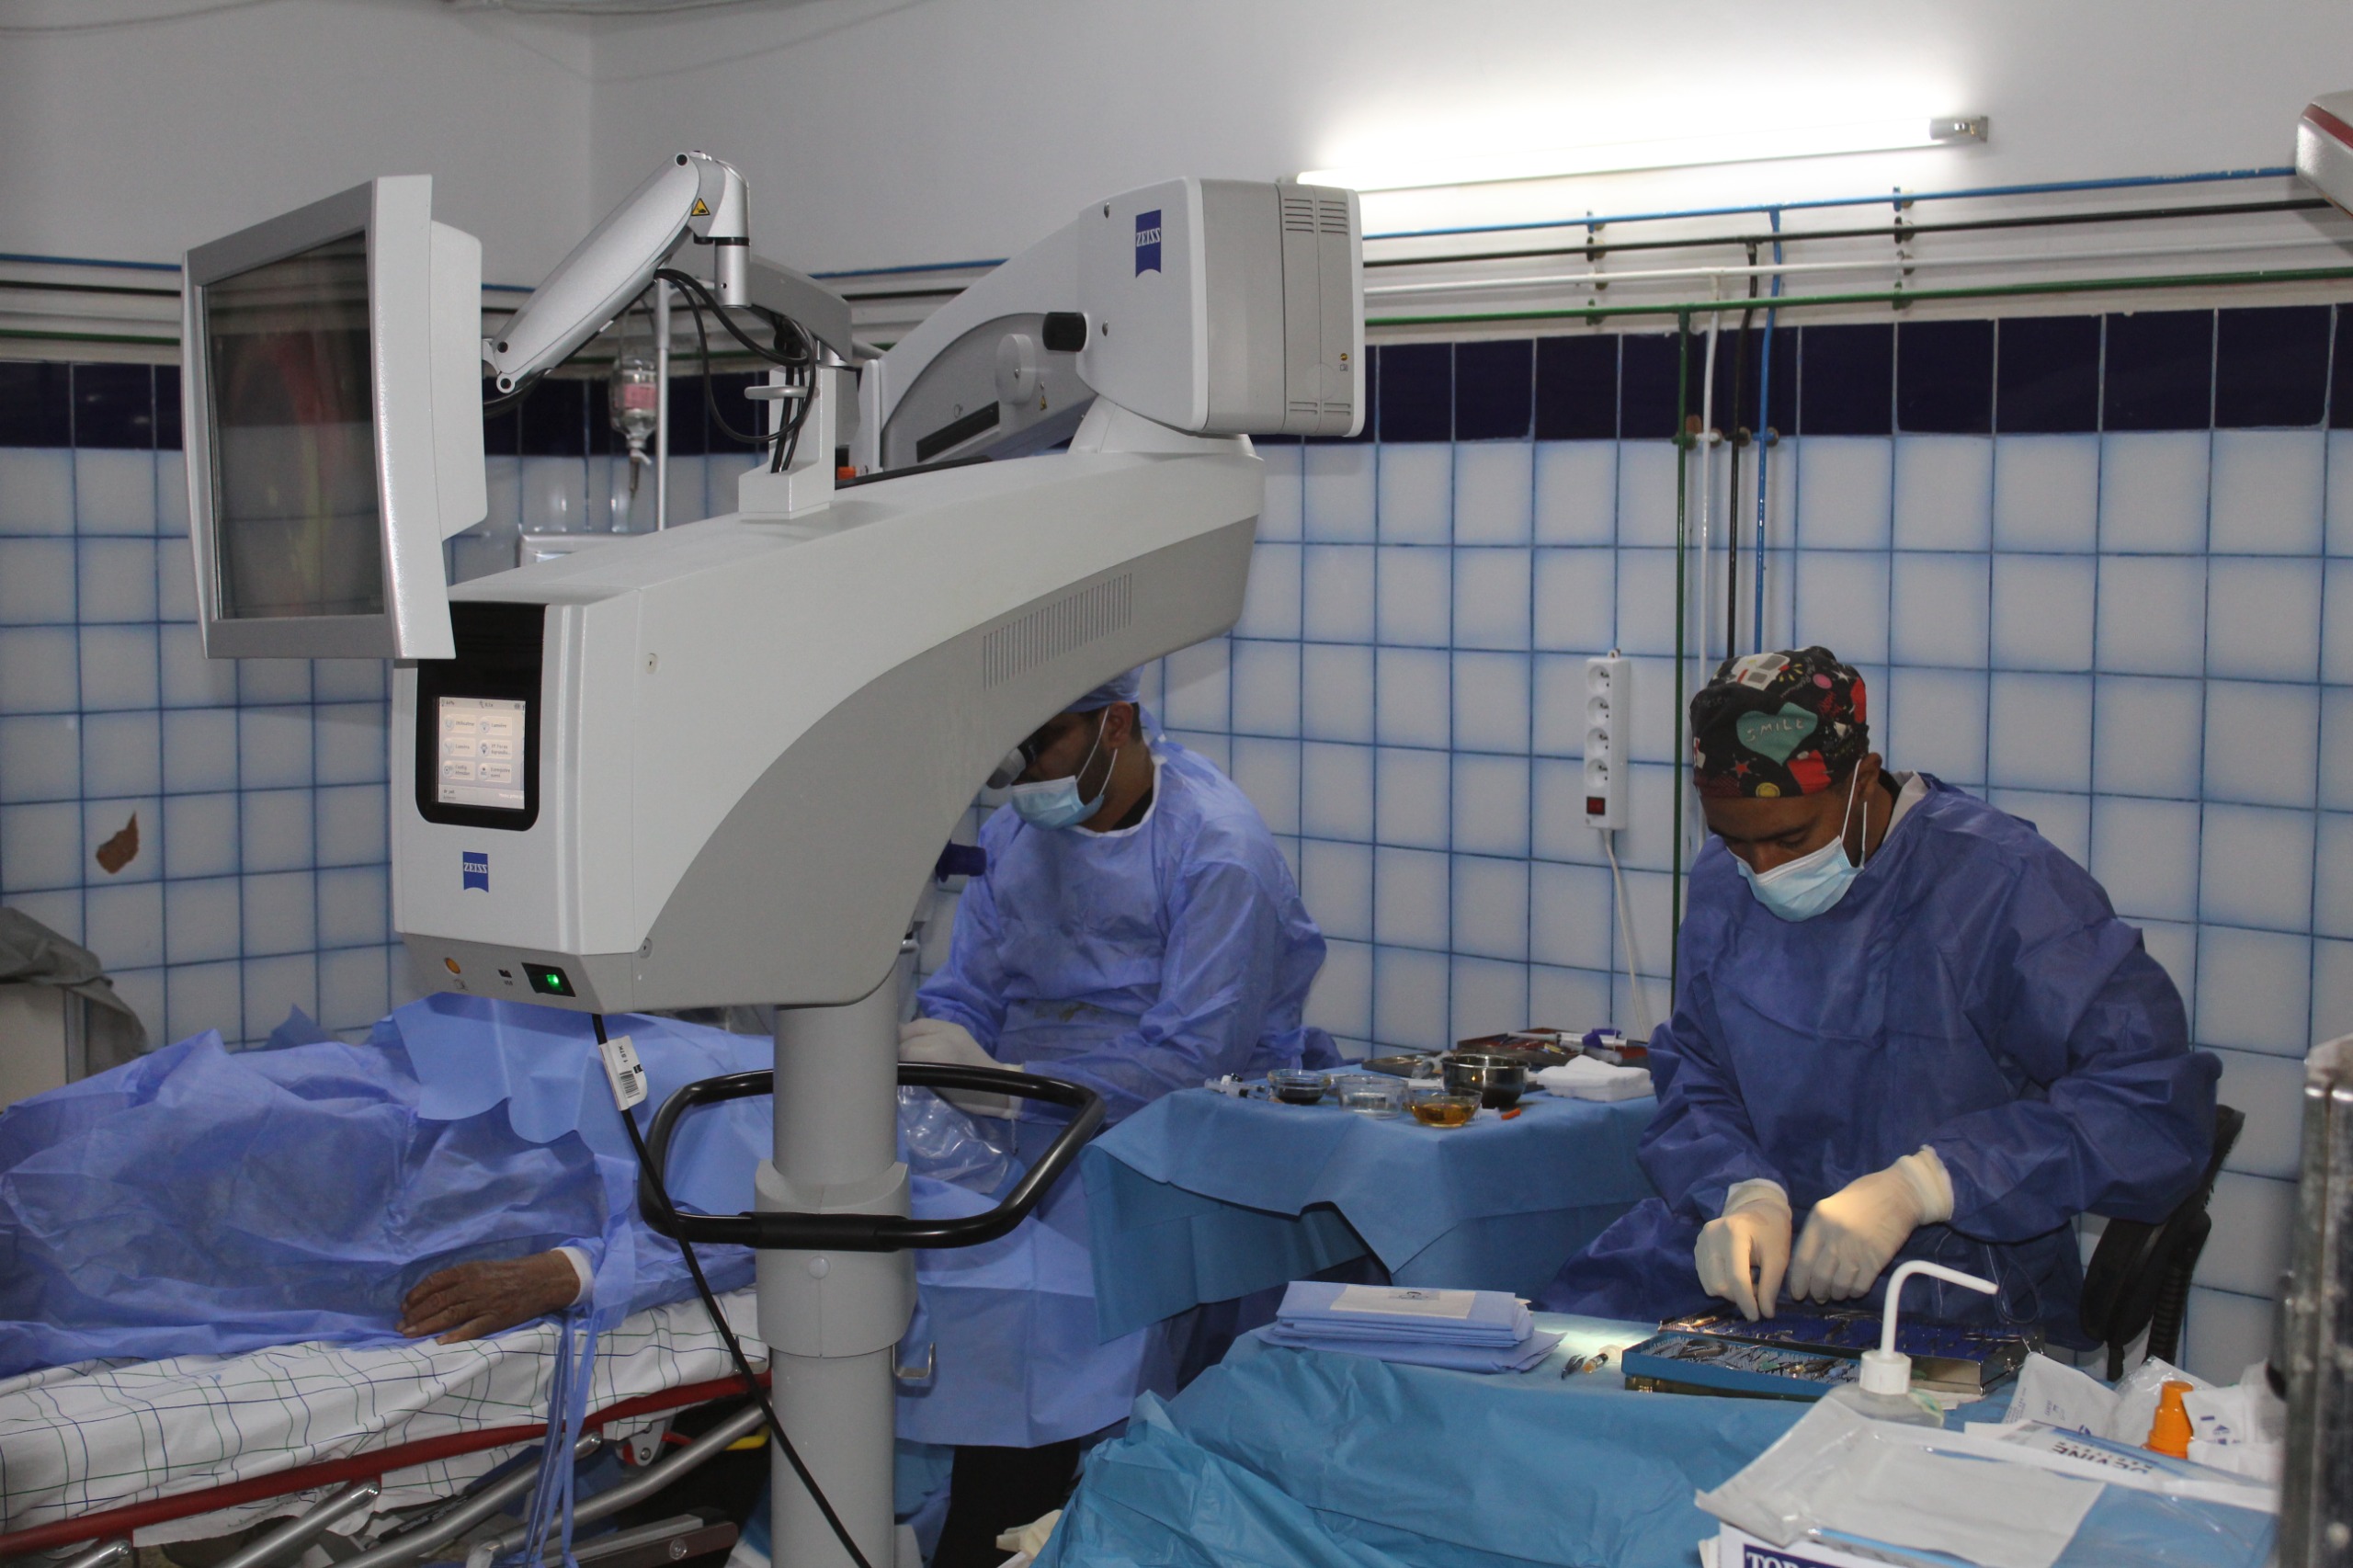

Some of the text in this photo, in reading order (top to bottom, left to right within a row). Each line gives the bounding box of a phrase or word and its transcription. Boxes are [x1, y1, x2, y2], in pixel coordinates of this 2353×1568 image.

[1136, 227, 1161, 247] ZEISS
[1746, 718, 1804, 742] SMILE
[463, 862, 487, 874] ZEISS
